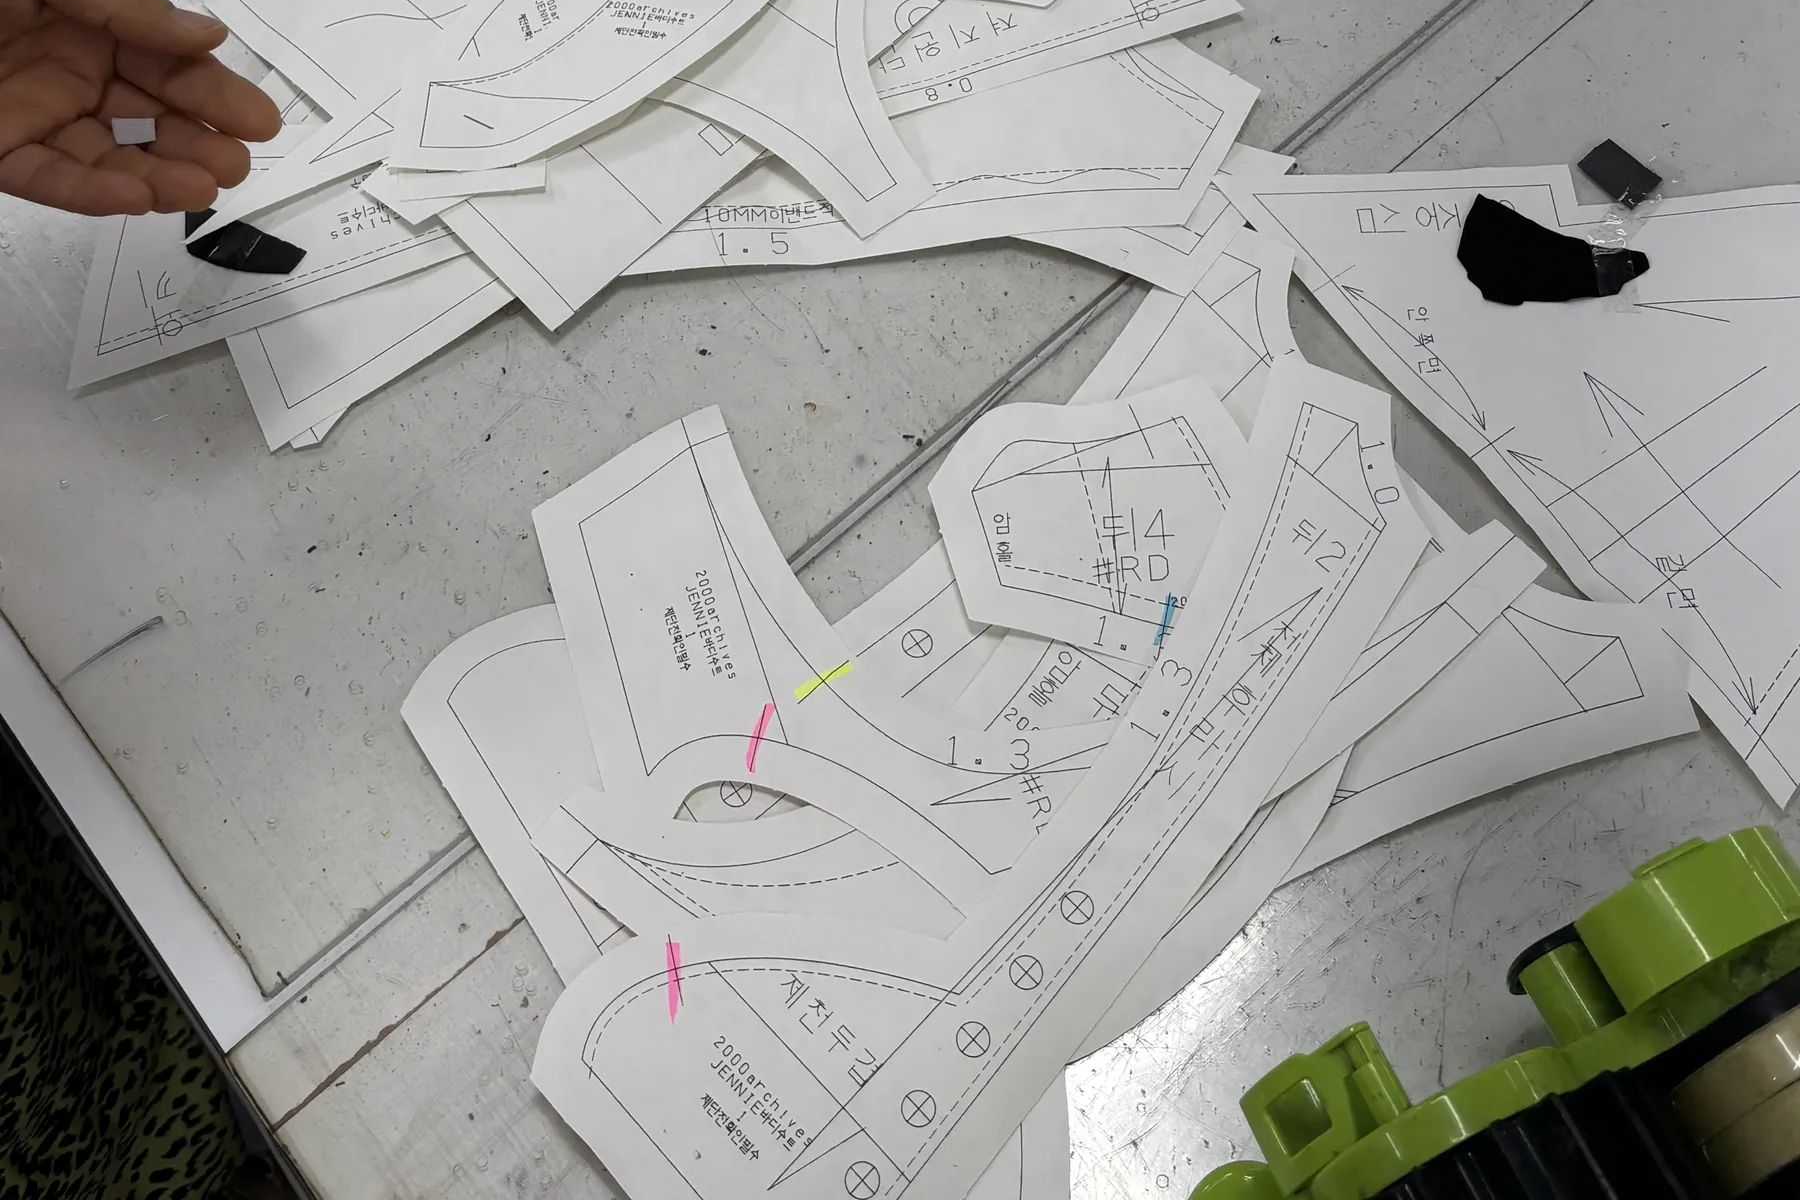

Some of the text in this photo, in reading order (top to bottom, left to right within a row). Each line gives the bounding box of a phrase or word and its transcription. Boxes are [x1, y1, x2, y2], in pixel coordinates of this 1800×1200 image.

[924, 76, 974, 103] 0.8
[716, 231, 791, 258] 1.5
[1357, 439, 1401, 506] 1.0
[1101, 506, 1176, 552] 뒤4
[1291, 517, 1347, 573] 뒤2
[1092, 553, 1171, 585] #RD
[685, 585, 723, 677] JENNIE바디수트
[695, 569, 737, 680] 2000archives
[1129, 658, 1194, 744] 1.3
[945, 734, 1031, 772] 1.3
[710, 1059, 796, 1152] JENNIE바디수트
[713, 1035, 814, 1148] 2000archives
